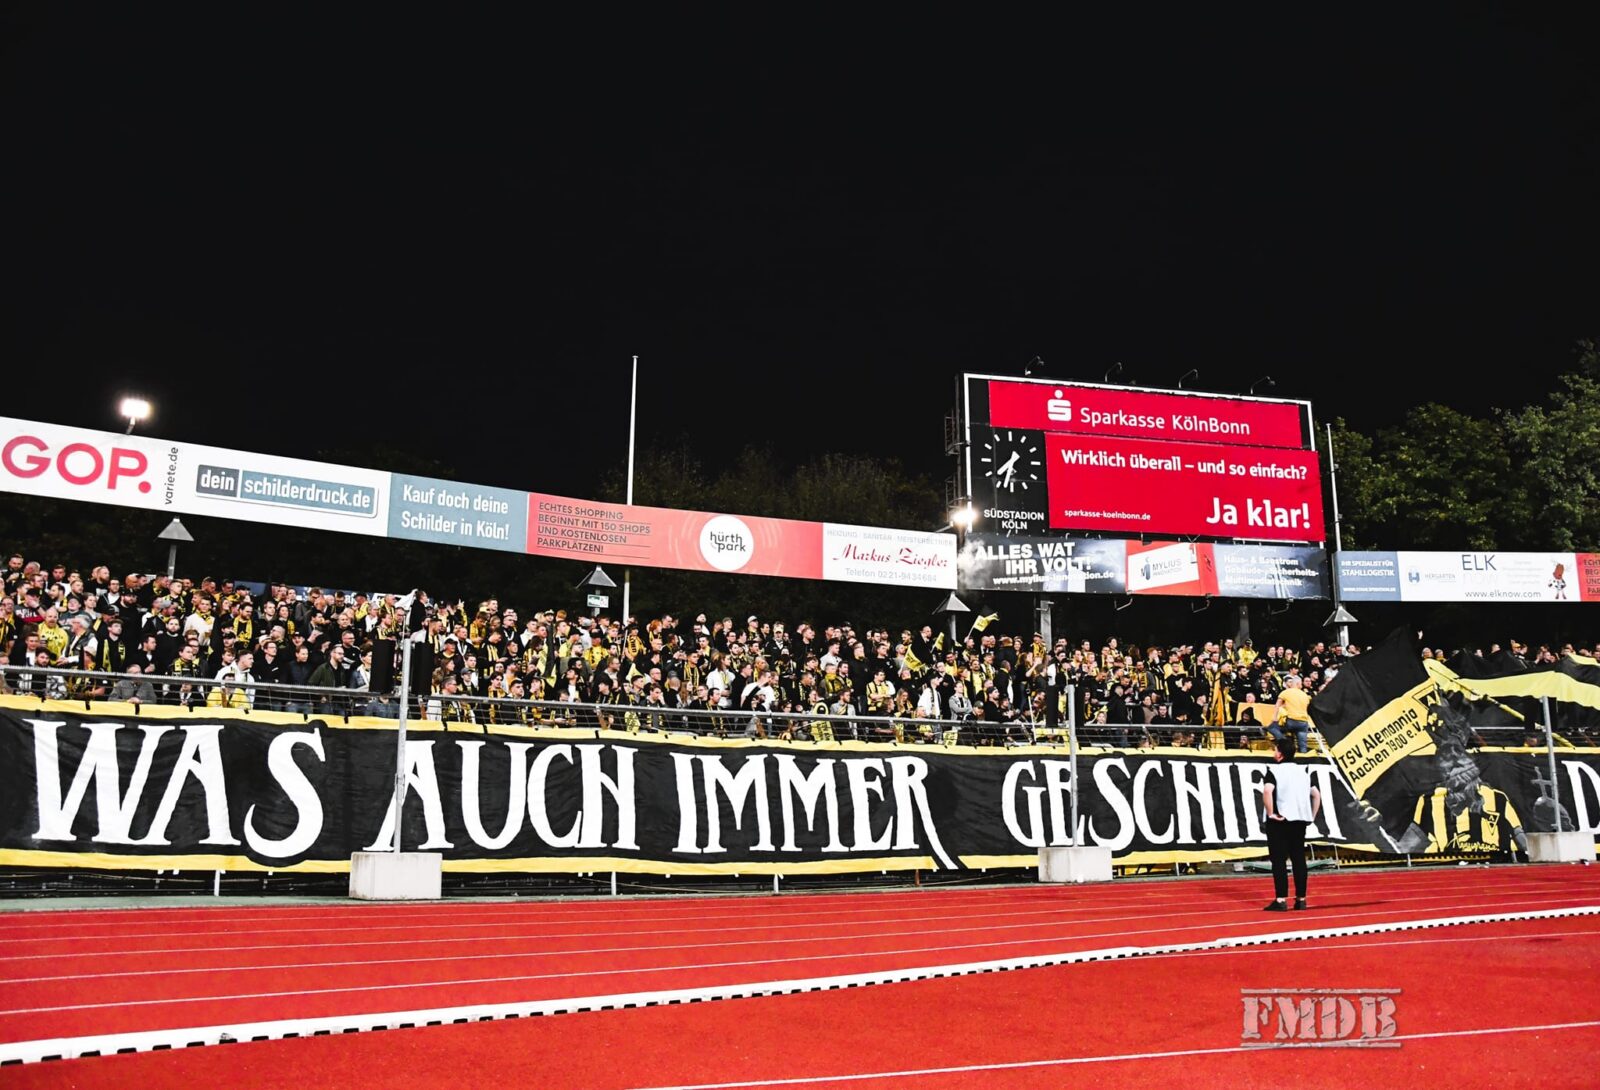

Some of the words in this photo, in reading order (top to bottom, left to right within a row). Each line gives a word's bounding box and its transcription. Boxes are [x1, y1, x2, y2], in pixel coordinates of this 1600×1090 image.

[1080, 407, 1166, 430] Sparkasse
[1172, 409, 1251, 436] KölnBonn
[1, 435, 152, 494] GOP.
[1061, 448, 1126, 469] Wirklich
[1129, 453, 1181, 472] überall
[1197, 459, 1224, 475] und
[1229, 465, 1246, 477] so
[1249, 461, 1307, 481] einfach?
[164, 446, 180, 505] variete.de
[200, 468, 235, 492] dein
[244, 477, 371, 509] schilderdruck.de
[403, 484, 436, 504] Kauf
[437, 490, 470, 508] doch
[473, 494, 509, 515] deine
[538, 502, 573, 516] ECHTES
[574, 506, 624, 520] SHOPPING
[983, 508, 1045, 521] SÜDSTADION
[1064, 507, 1151, 522] sparkasse-koelnbonn.de
[1205, 497, 1239, 526] Ja
[1247, 498, 1311, 529] klar!
[401, 511, 458, 534] Schilder
[460, 518, 473, 535] in
[476, 520, 510, 541] Köln!
[538, 513, 580, 528] BEGINNT
[581, 518, 599, 530] MIT
[600, 521, 616, 532] 150
[618, 523, 651, 535] SHOPS
[1001, 519, 1028, 530] KÖLN
[537, 525, 558, 537] UND
[560, 527, 627, 544] KOSTENLOSEN
[709, 531, 743, 545] hürth
[536, 537, 604, 553] PARKPLÄTZEN!
[717, 543, 747, 554] park
[975, 543, 1034, 561] ALLES
[1037, 541, 1076, 558] WAT
[832, 543, 891, 563] Markus
[896, 547, 948, 570] Ziegler
[1005, 559, 1038, 576] IHR
[1042, 556, 1092, 573] VOLT!
[1152, 558, 1183, 571] MYLIUS
[1461, 554, 1497, 571] ELK
[845, 567, 876, 578] Telefon
[1341, 569, 1395, 577] STAHLLOGISTIK
[1464, 589, 1542, 598] www.elknow.com
[1362, 708, 1418, 753] Alemannia
[1338, 744, 1363, 769] TSV
[1348, 747, 1390, 783] Aachen
[1385, 733, 1408, 752] 1900
[23, 718, 327, 859] WAS
[363, 738, 641, 852] AUCH
[669, 752, 960, 870] IMMER
